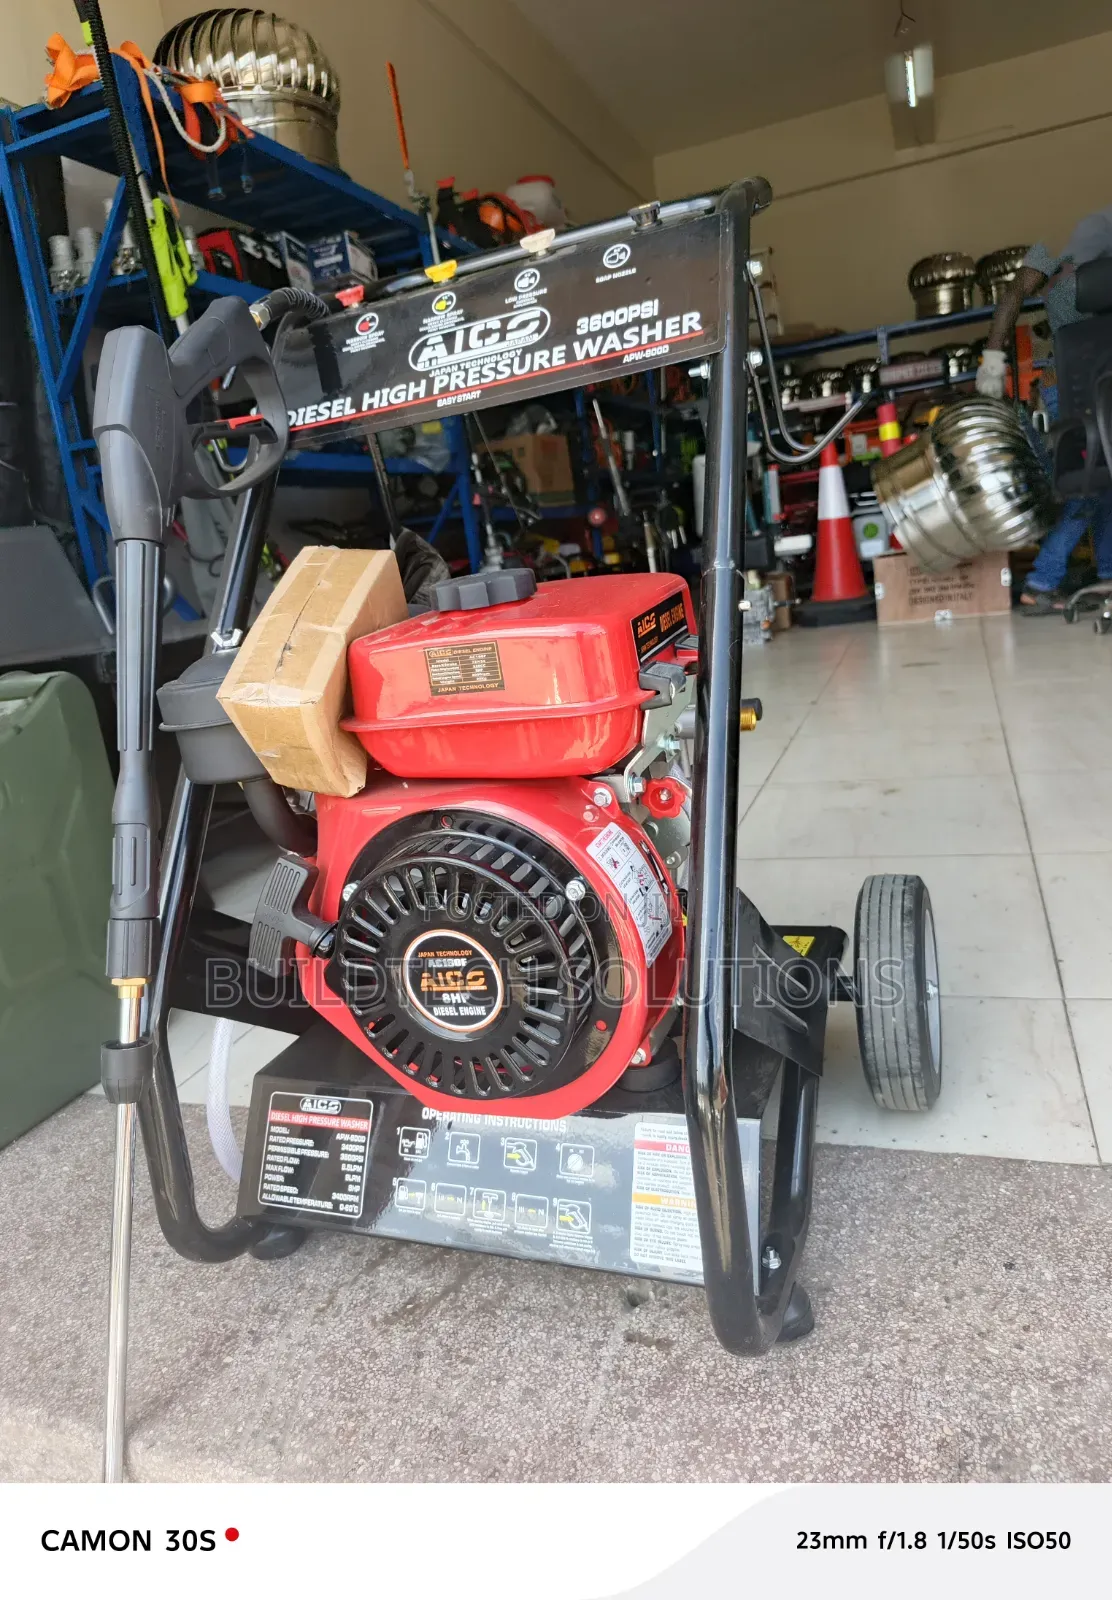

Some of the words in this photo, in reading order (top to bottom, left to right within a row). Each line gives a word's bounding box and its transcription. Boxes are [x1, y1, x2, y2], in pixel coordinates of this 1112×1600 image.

[504, 296, 518, 304] LOW
[576, 298, 659, 335] 3600PSI
[415, 309, 541, 369] AICS
[287, 397, 356, 427] DIESEL
[362, 379, 427, 412] HIGH
[433, 344, 567, 395] PRESSURE
[573, 311, 703, 360] WASHER
[429, 365, 458, 378] JAPAN
[460, 348, 522, 368] TECHNOLOGY
[437, 396, 459, 408] EASY
[458, 390, 482, 403] START
[637, 612, 656, 638] AICS
[459, 682, 498, 691] TECHNOLOGY
[436, 950, 472, 958] TECHNOLOGY
[420, 970, 488, 992] AICS
[442, 992, 470, 1004] 8HP
[433, 1006, 458, 1016] DIESEL
[459, 1006, 486, 1016] ENGINE
[302, 1098, 340, 1114] AICS
[271, 1112, 291, 1121] DIESEL
[292, 1114, 308, 1122] HIGH
[308, 1116, 340, 1127] PRESSURE
[340, 1120, 369, 1130] WASHER
[422, 1107, 480, 1124] OPERATING
[484, 1115, 567, 1132] INSTRUCTIONS
[269, 1135, 286, 1144] RATED
[444, 1132, 450, 1140] 2
[666, 1143, 690, 1153] DANG
[266, 1154, 284, 1162] RATED
[266, 1164, 278, 1172] MAX
[262, 1193, 294, 1204] ALLOWABLE
[661, 1196, 697, 1209] WARNIN
